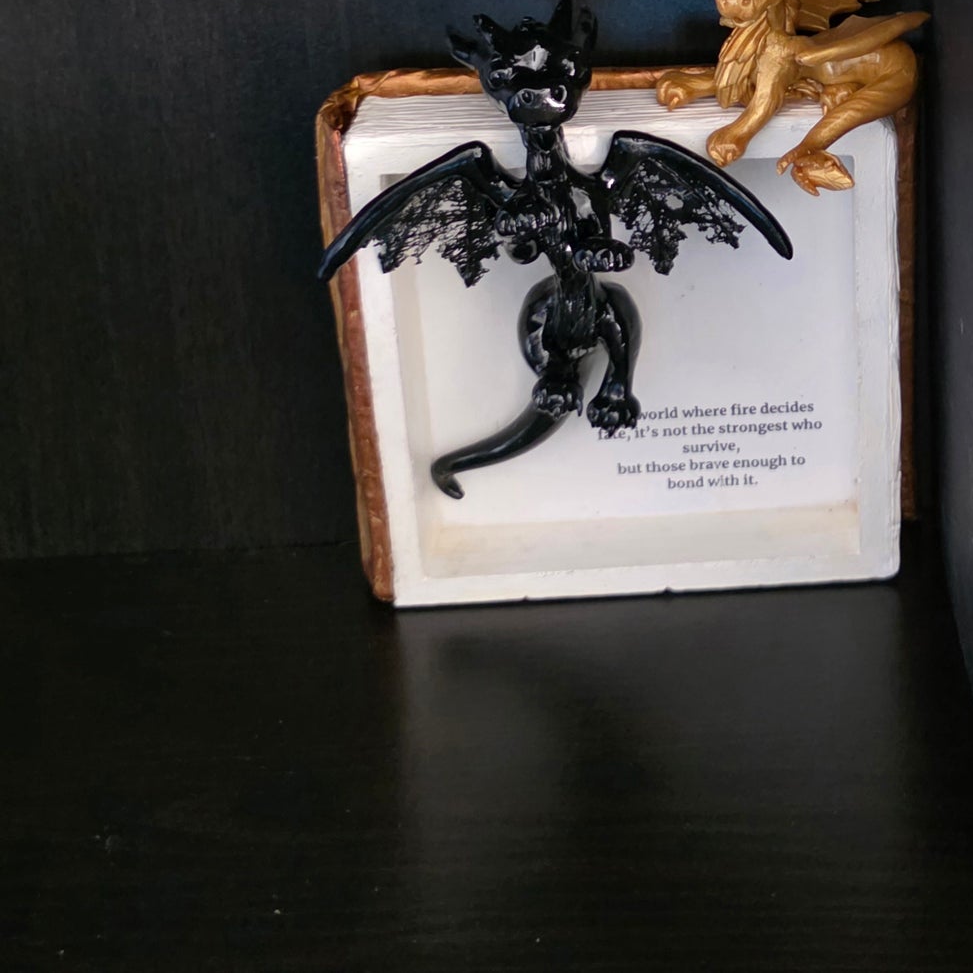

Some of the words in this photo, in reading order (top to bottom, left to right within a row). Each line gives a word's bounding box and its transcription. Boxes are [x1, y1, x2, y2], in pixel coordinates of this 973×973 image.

[682, 406, 727, 418] where
[731, 404, 757, 416] fire
[760, 401, 814, 414] decides
[663, 426, 687, 437] not
[691, 424, 715, 435] the
[719, 421, 787, 435] strongest
[791, 419, 822, 430] who
[683, 441, 740, 454] survive,
[618, 463, 642, 474] but
[646, 461, 686, 472] those
[690, 459, 729, 470] brave
[733, 455, 787, 469] enough
[791, 455, 805, 466] to
[668, 477, 704, 489] bond
[708, 476, 739, 487] with
[743, 474, 758, 485] it.
